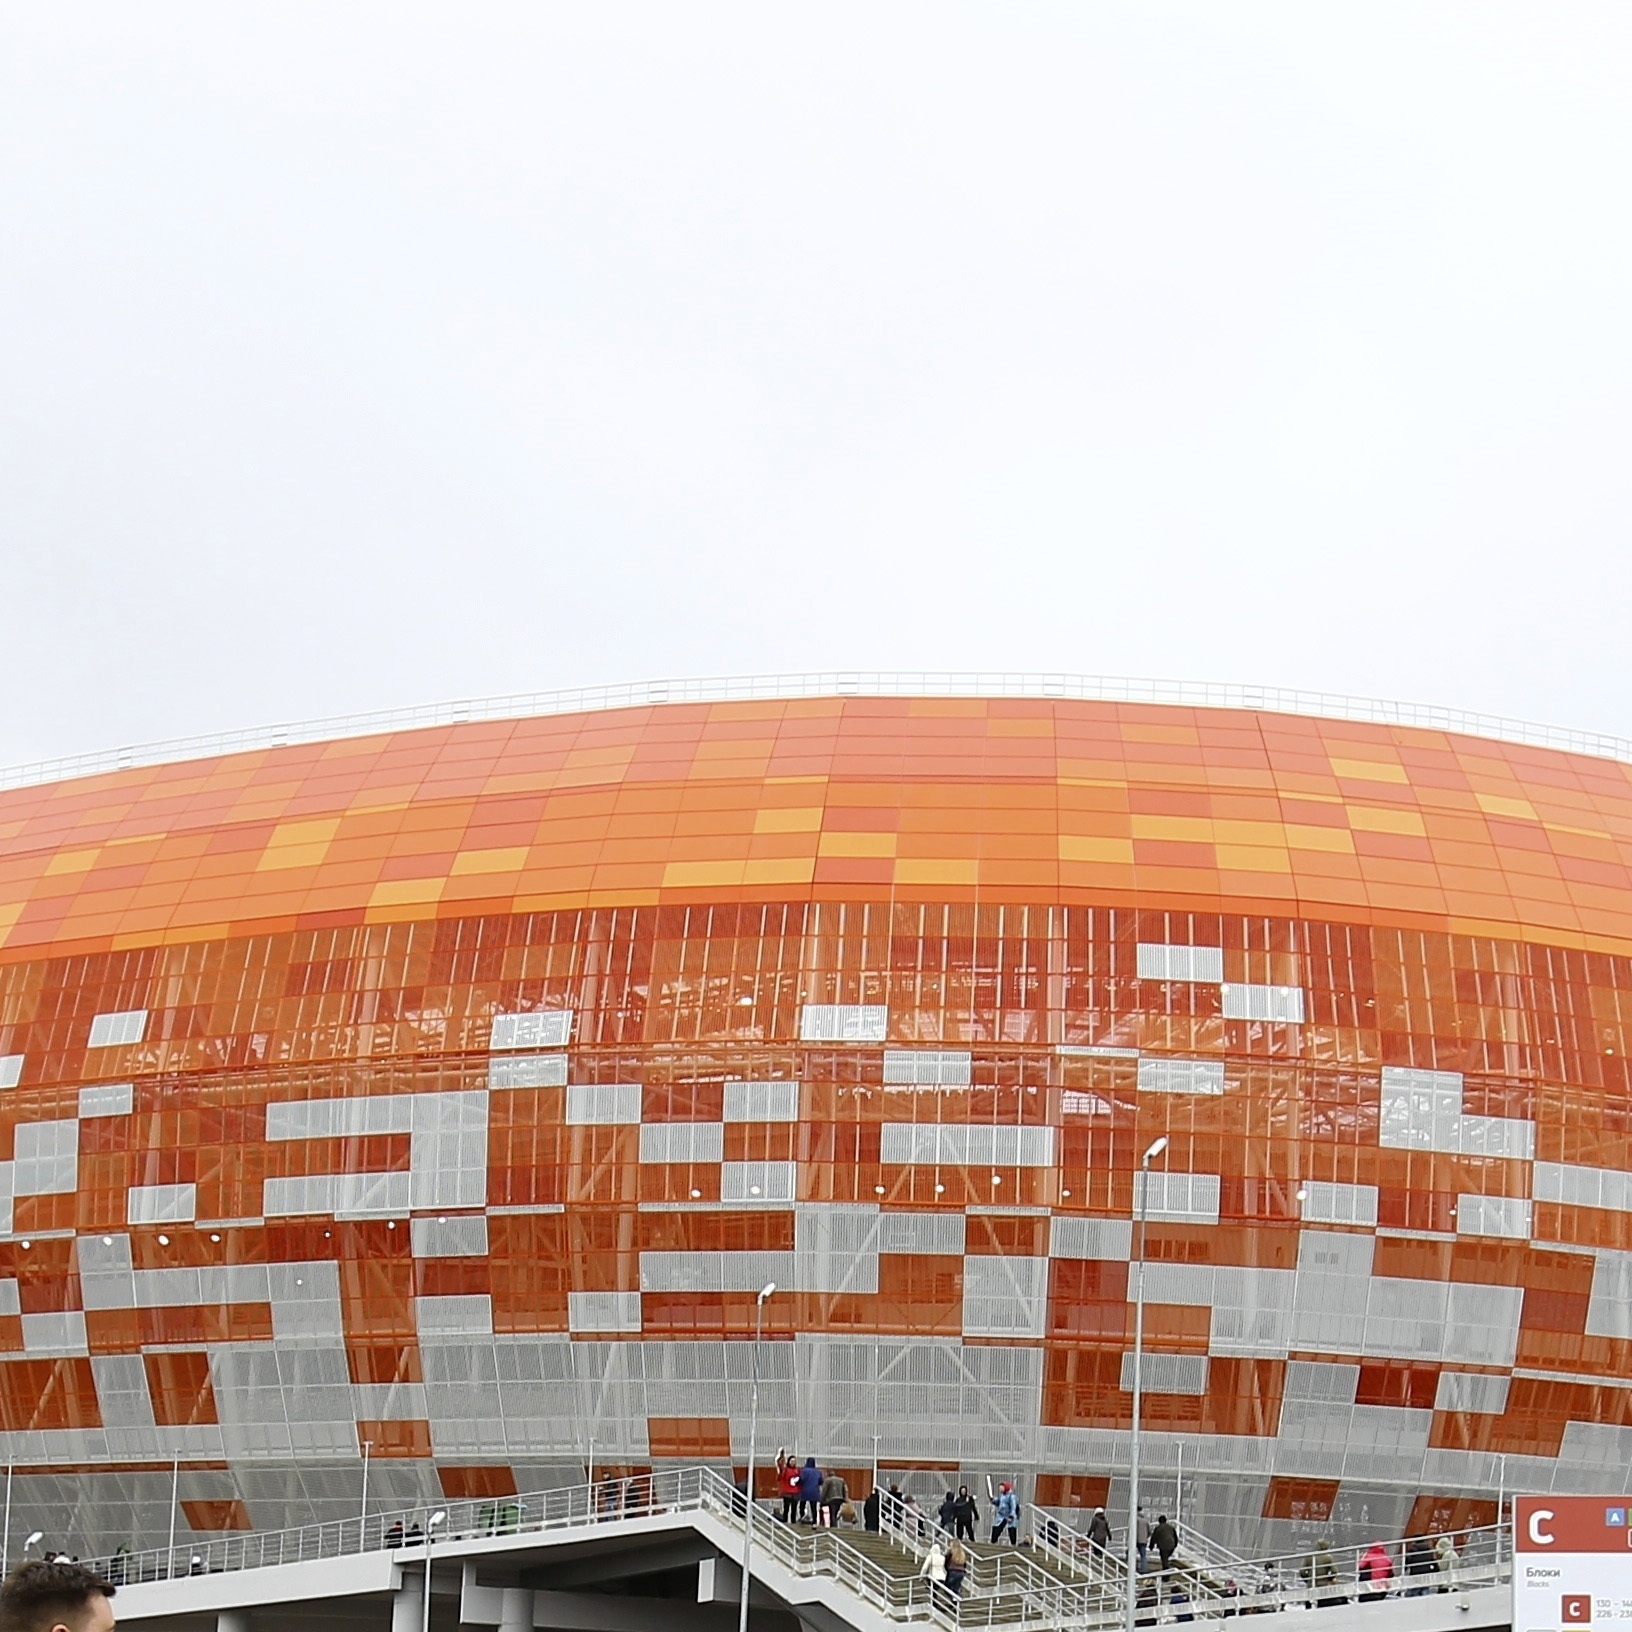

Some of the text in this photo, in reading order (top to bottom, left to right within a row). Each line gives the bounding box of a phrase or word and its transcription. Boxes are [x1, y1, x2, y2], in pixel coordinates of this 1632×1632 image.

[1611, 1512, 1620, 1522] A
[1529, 1510, 1554, 1544] C
[1526, 1566, 1561, 1578] Блоки
[1526, 1580, 1550, 1588] Blocks
[1596, 1599, 1611, 1608] 130
[1569, 1602, 1581, 1617] C
